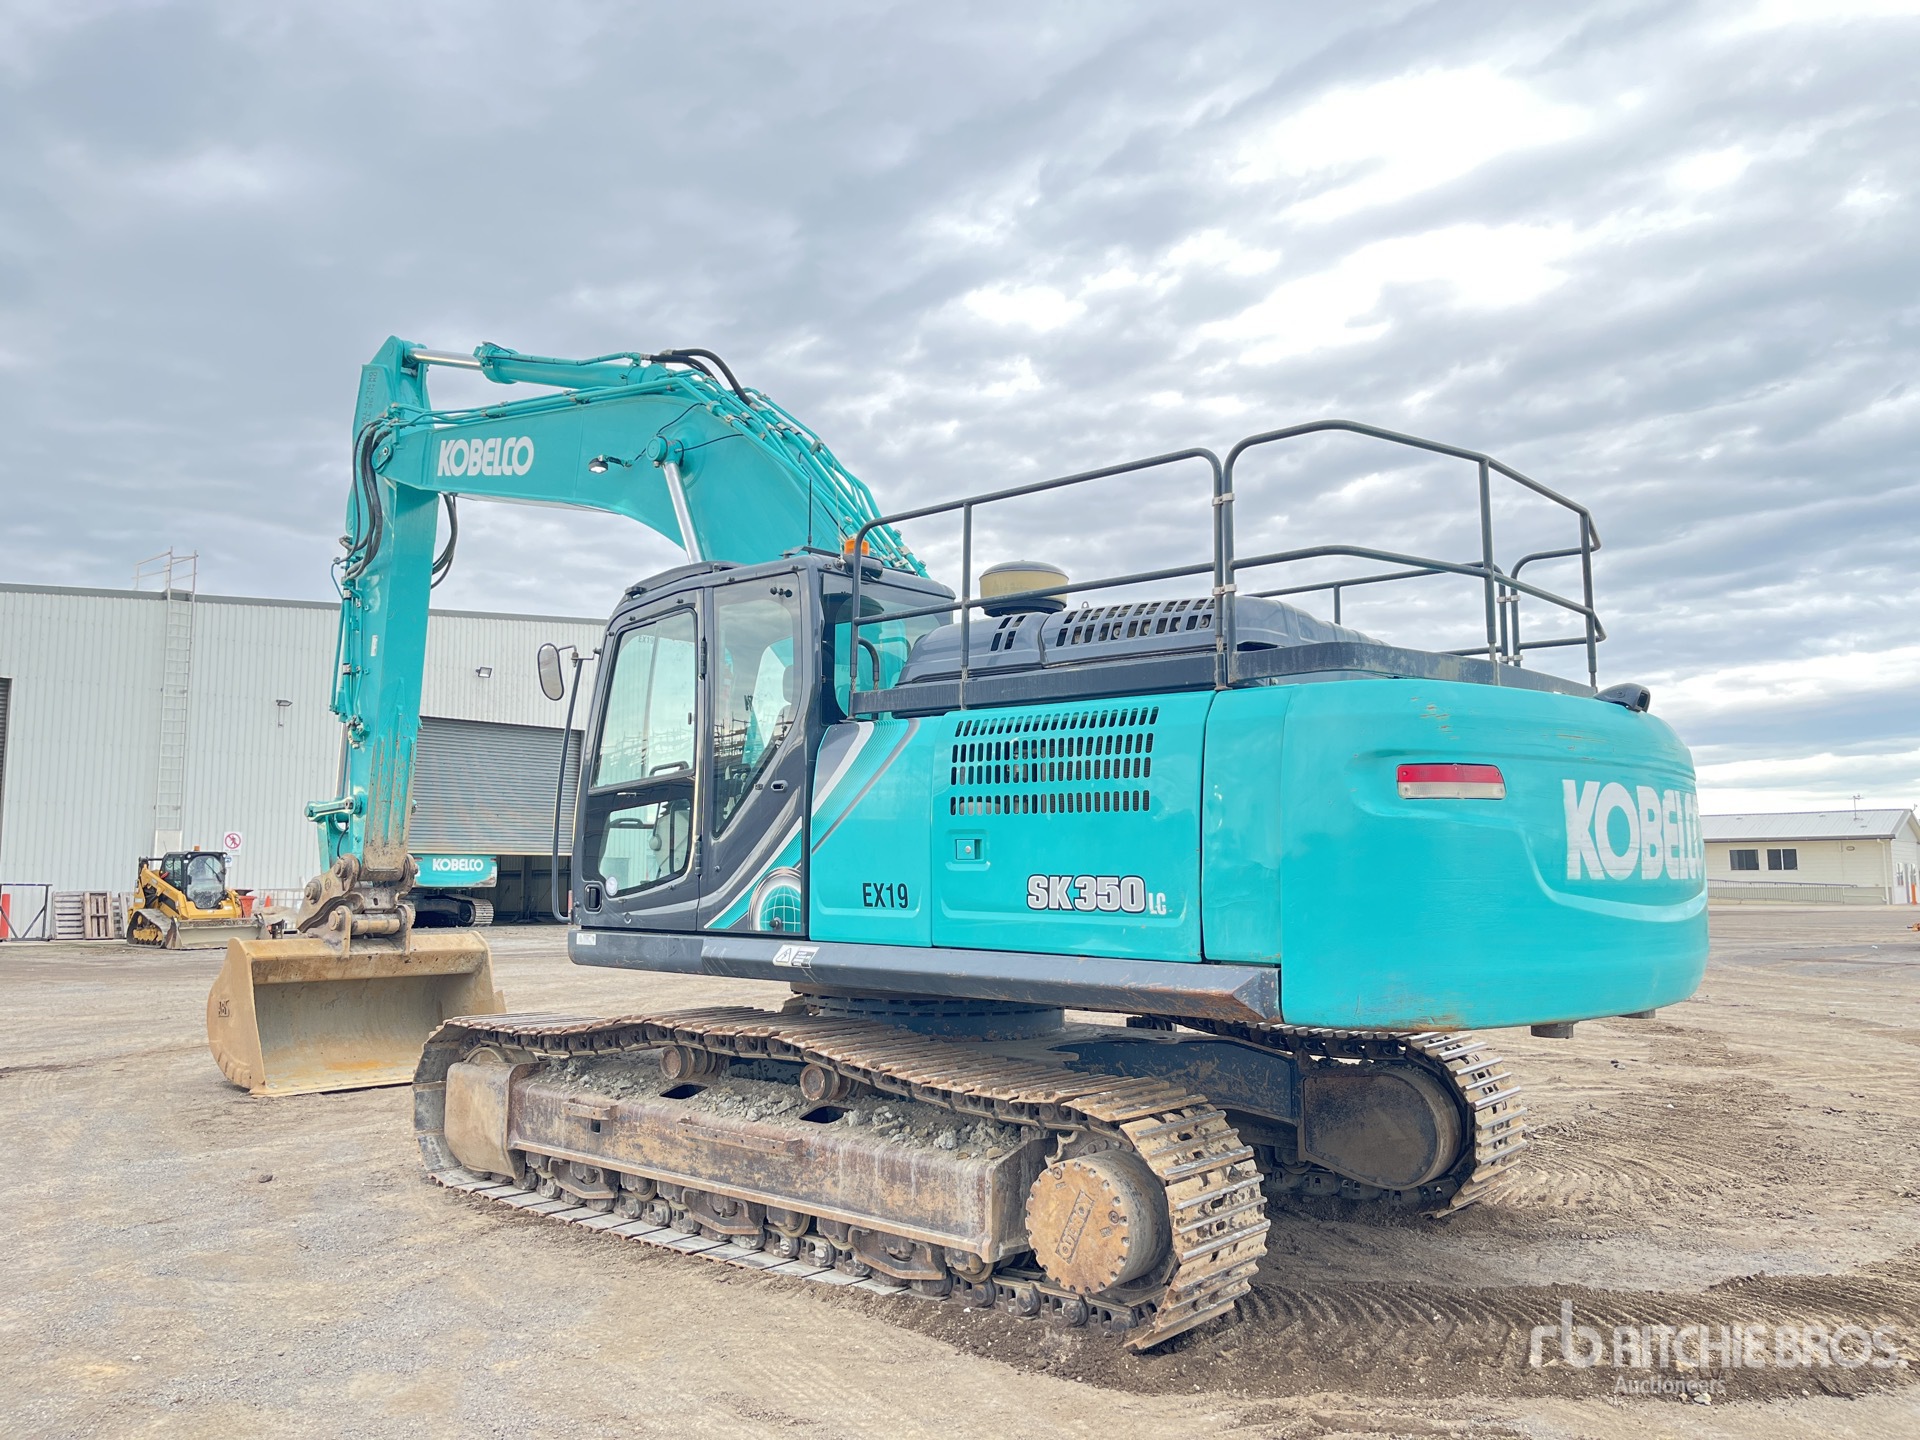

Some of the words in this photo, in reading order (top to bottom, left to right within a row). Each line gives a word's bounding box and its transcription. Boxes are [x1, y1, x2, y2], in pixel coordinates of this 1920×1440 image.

[437, 436, 534, 476] KOBELCO
[432, 858, 484, 872] KOBELCO
[862, 882, 909, 908] EX19
[1026, 874, 1147, 913] SK350
[1149, 892, 1167, 915] LC
